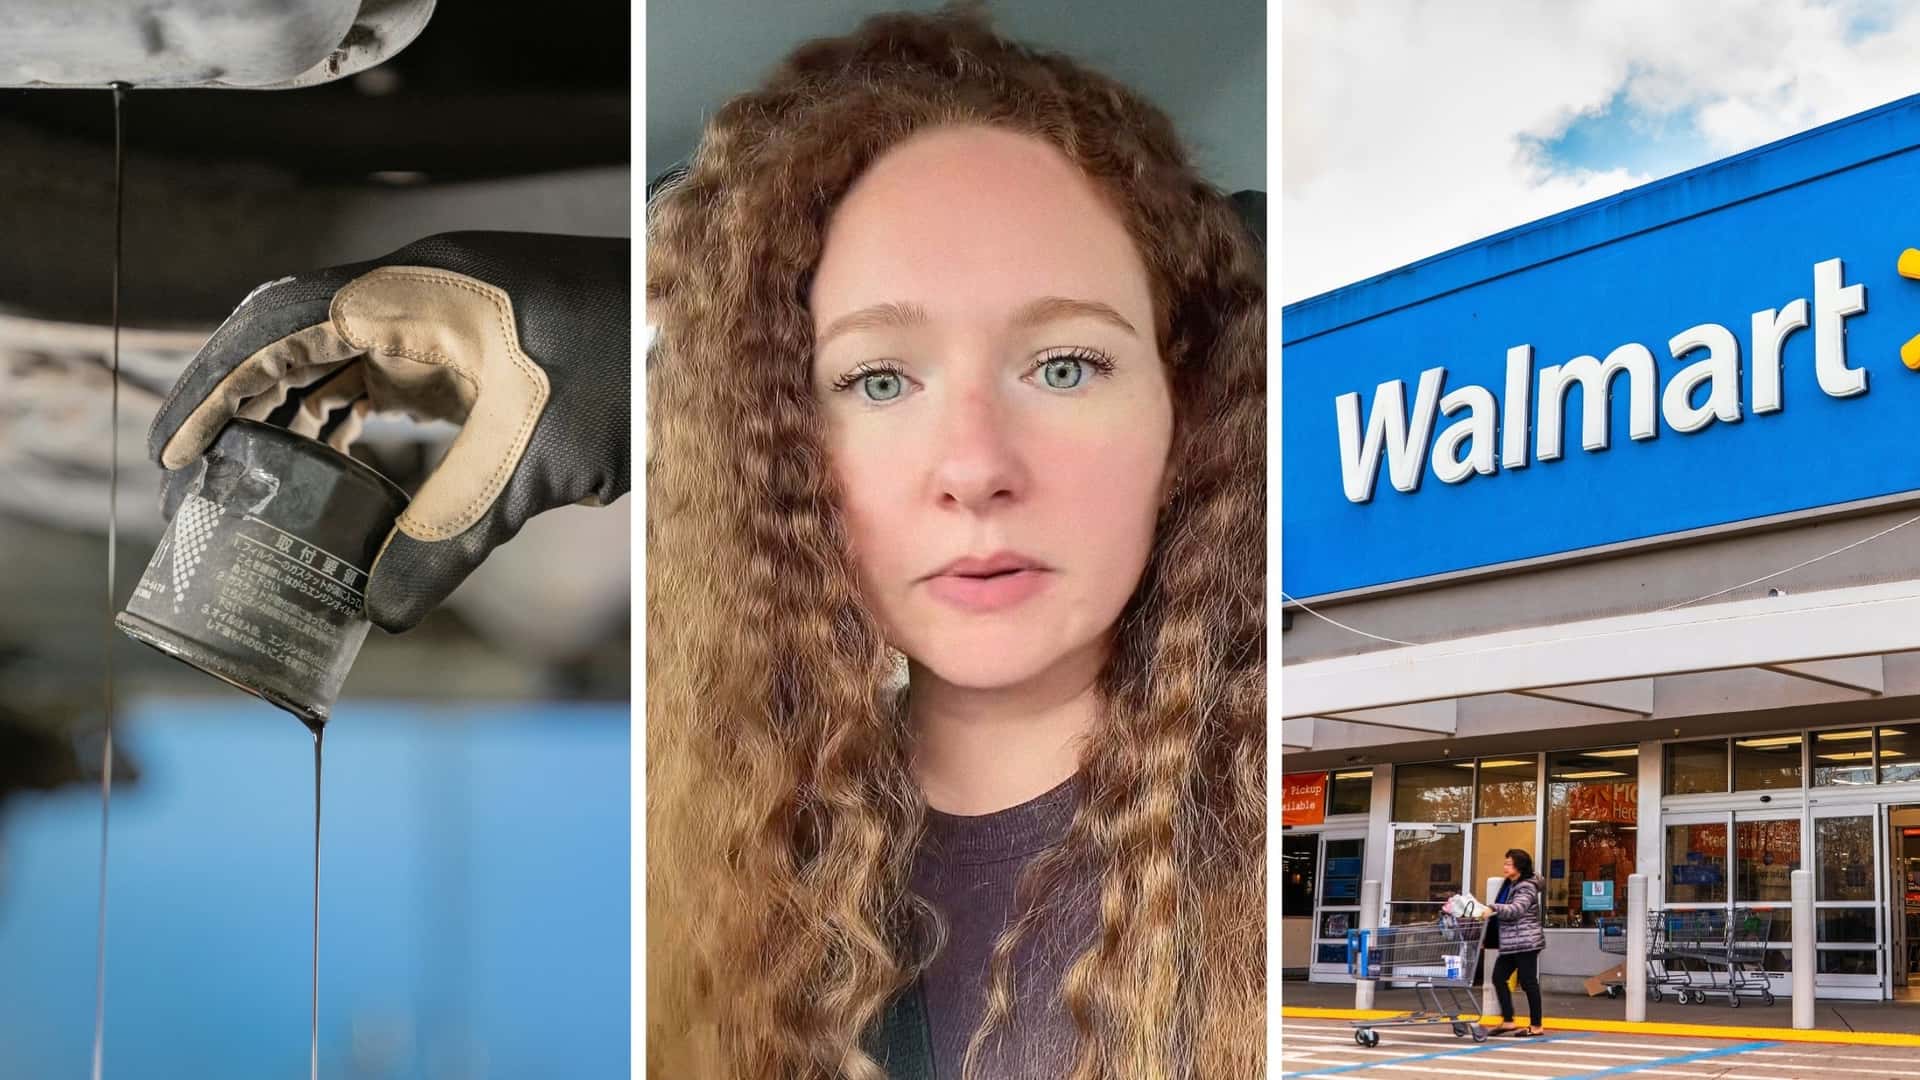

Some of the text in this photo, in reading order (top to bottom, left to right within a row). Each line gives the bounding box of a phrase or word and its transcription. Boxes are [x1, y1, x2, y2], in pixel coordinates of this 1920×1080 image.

[1336, 257, 1868, 503] Walmart
[274, 533, 359, 587] 取付要領
[1291, 785, 1322, 796] Pickup
